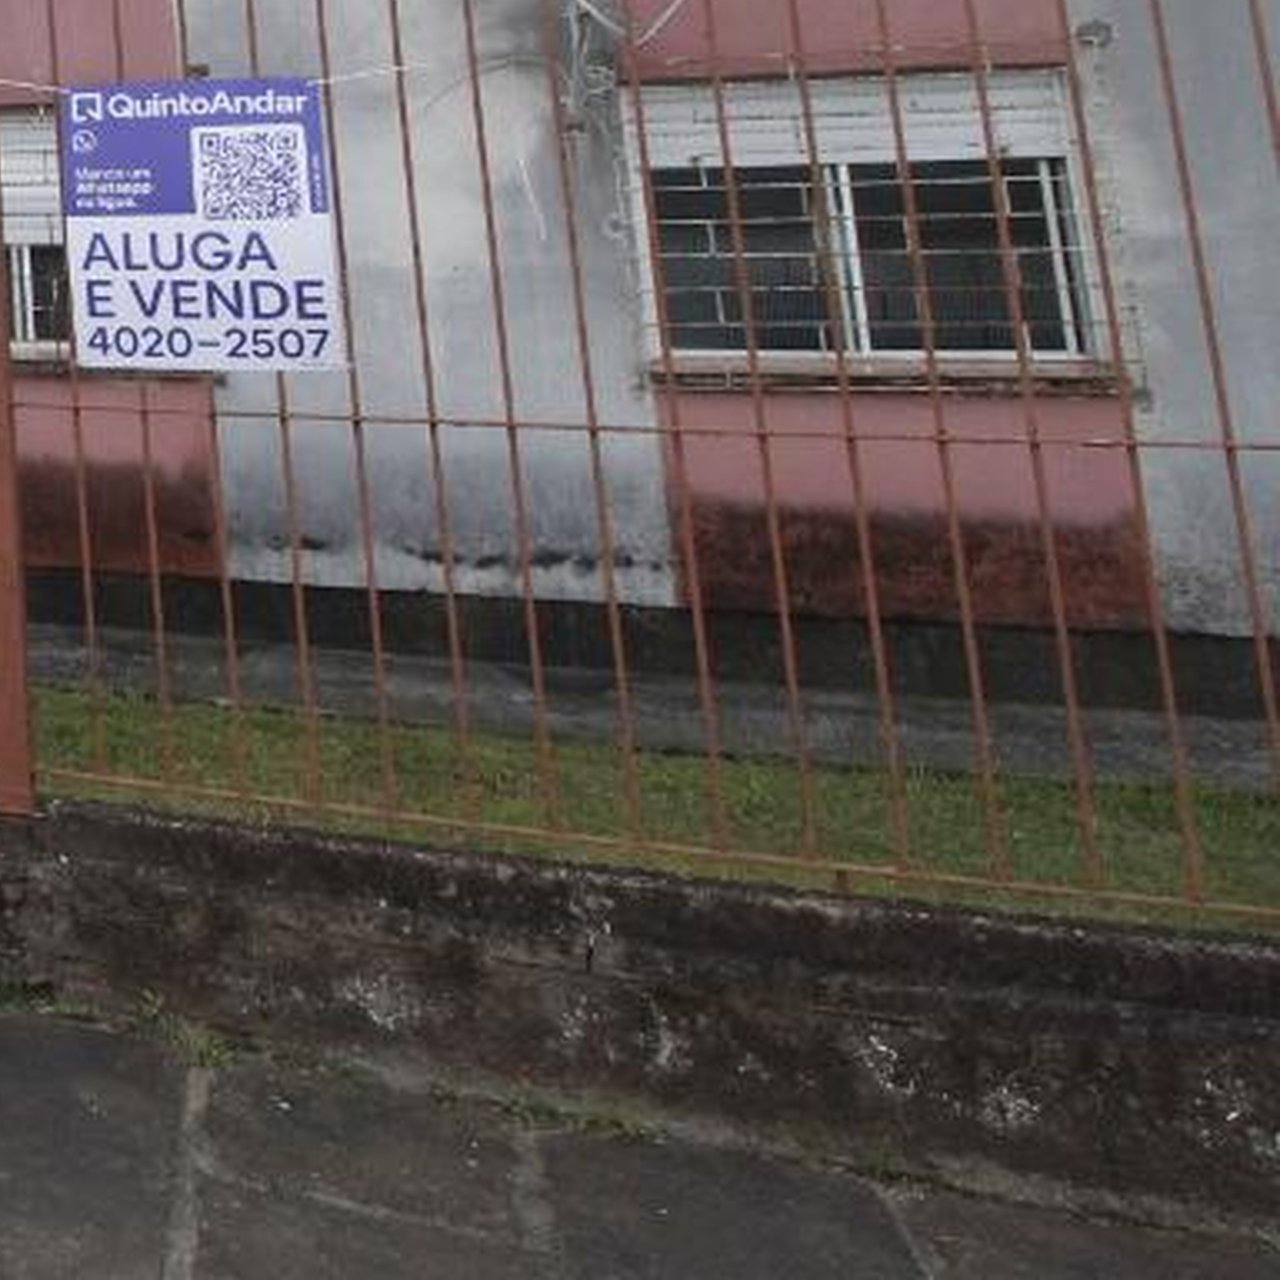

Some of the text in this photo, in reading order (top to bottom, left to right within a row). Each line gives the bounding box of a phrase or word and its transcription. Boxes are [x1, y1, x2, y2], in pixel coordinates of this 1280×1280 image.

[107, 90, 308, 118] QuintoAndar
[83, 232, 277, 271] ALUGA
[86, 280, 328, 320] E VENDE
[88, 327, 329, 358] 4020-2507
